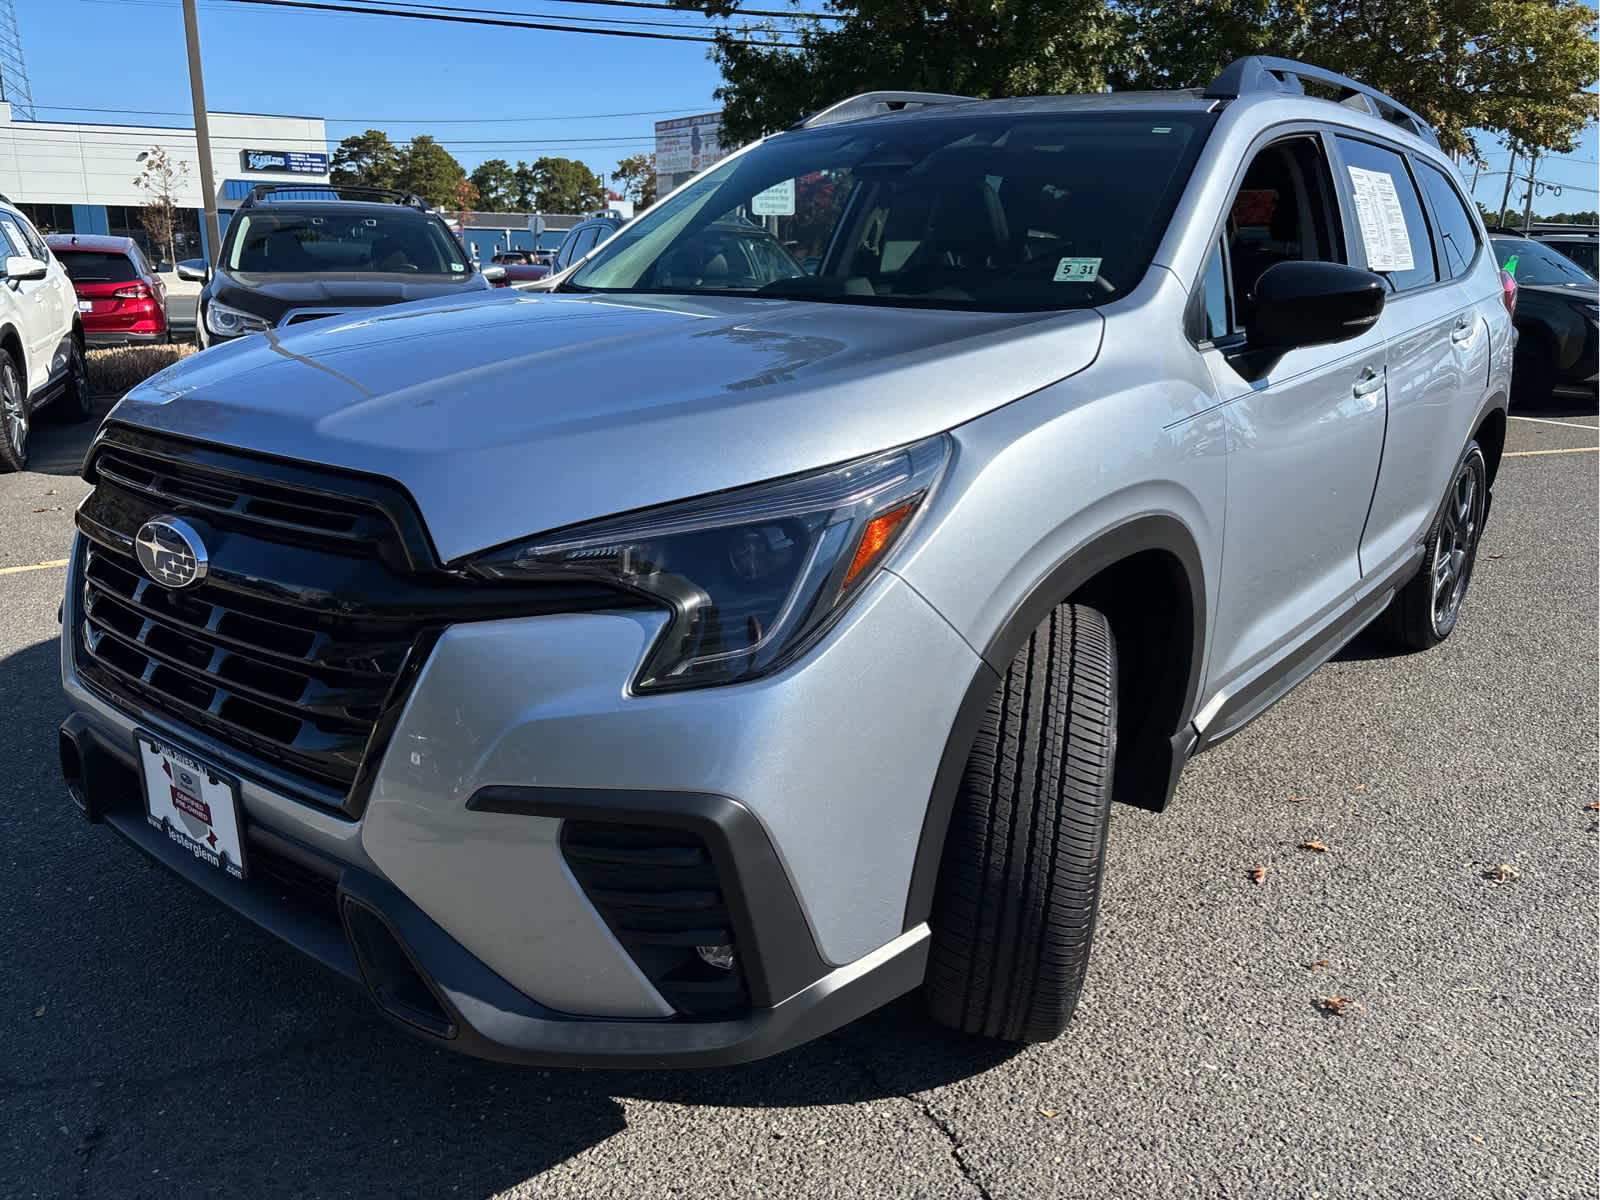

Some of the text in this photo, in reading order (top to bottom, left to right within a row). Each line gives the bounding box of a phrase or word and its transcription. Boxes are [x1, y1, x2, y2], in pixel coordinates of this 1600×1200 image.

[1063, 264, 1094, 275] 5 31
[175, 798, 209, 821] PRE-OWNED
[176, 790, 205, 812] CERTIFIED
[167, 826, 220, 868] lesterglenn
